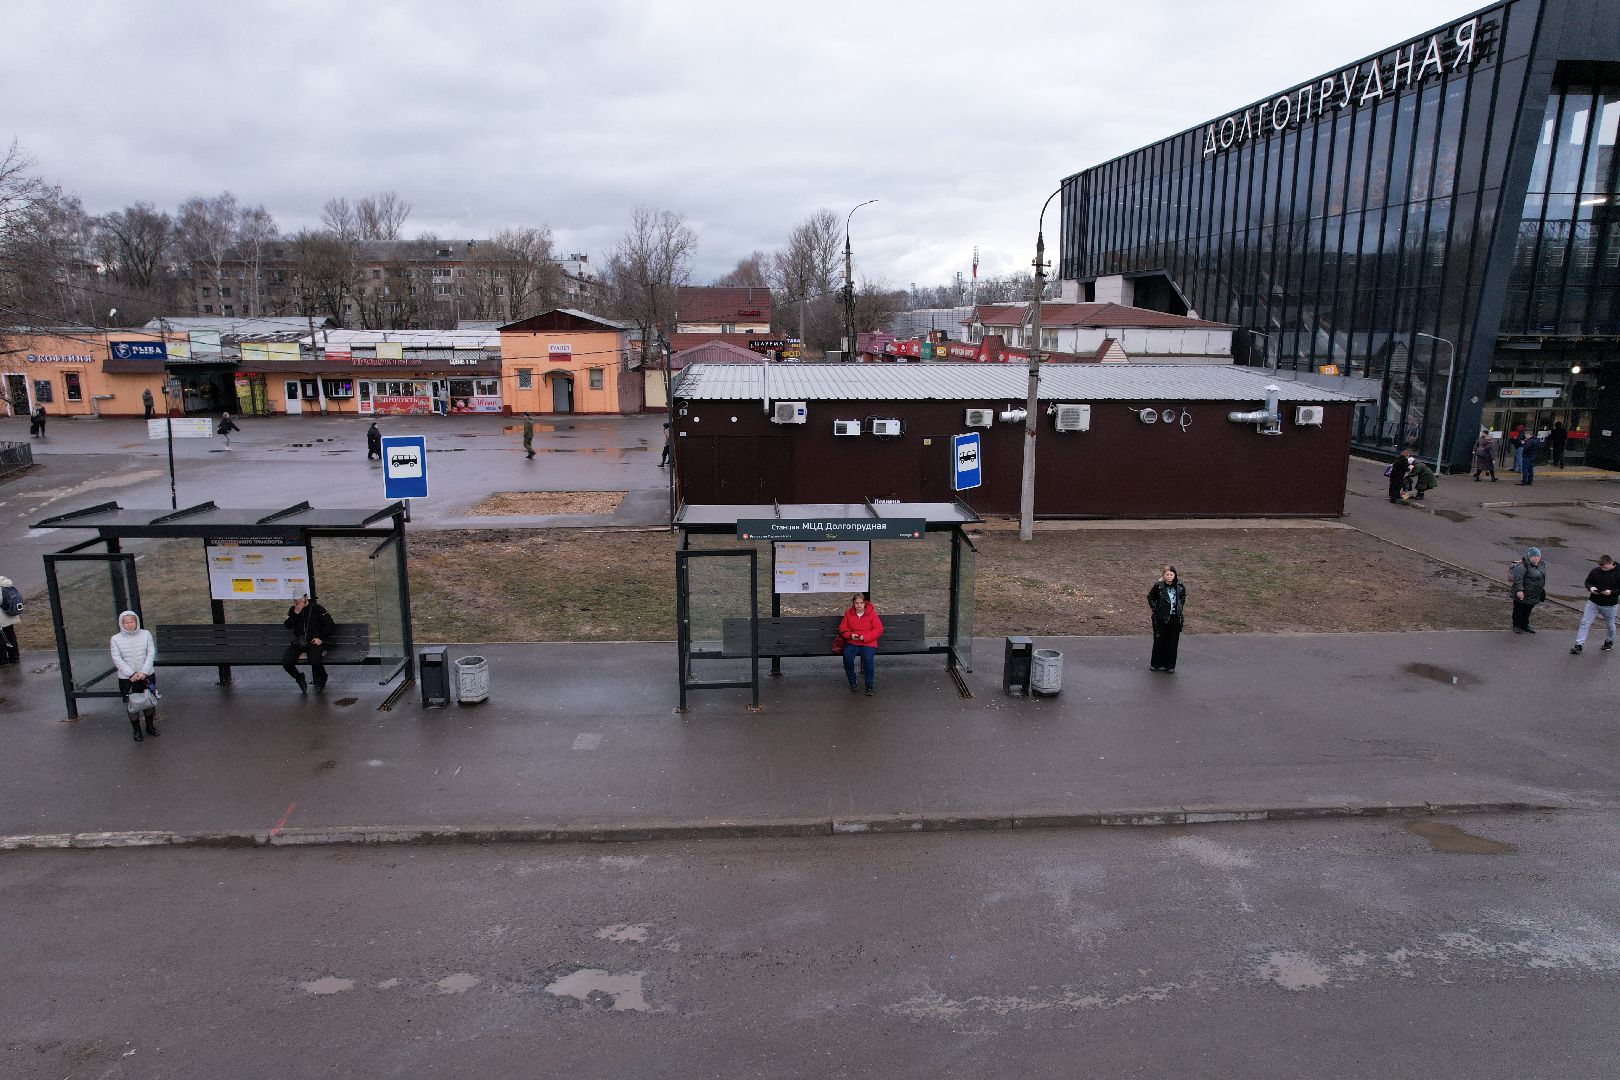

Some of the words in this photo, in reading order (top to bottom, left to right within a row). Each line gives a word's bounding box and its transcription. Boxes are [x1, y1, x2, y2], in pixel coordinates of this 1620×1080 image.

[1203, 17, 1478, 158] ДОЛГОПРУДНАЯ
[132, 346, 163, 355] РЫБА
[38, 353, 93, 363] КОФЕЙНЯ
[449, 358, 478, 366] ЦВЕТЫ
[802, 522, 824, 531] МЦД
[825, 522, 887, 531] Долгопрудная
